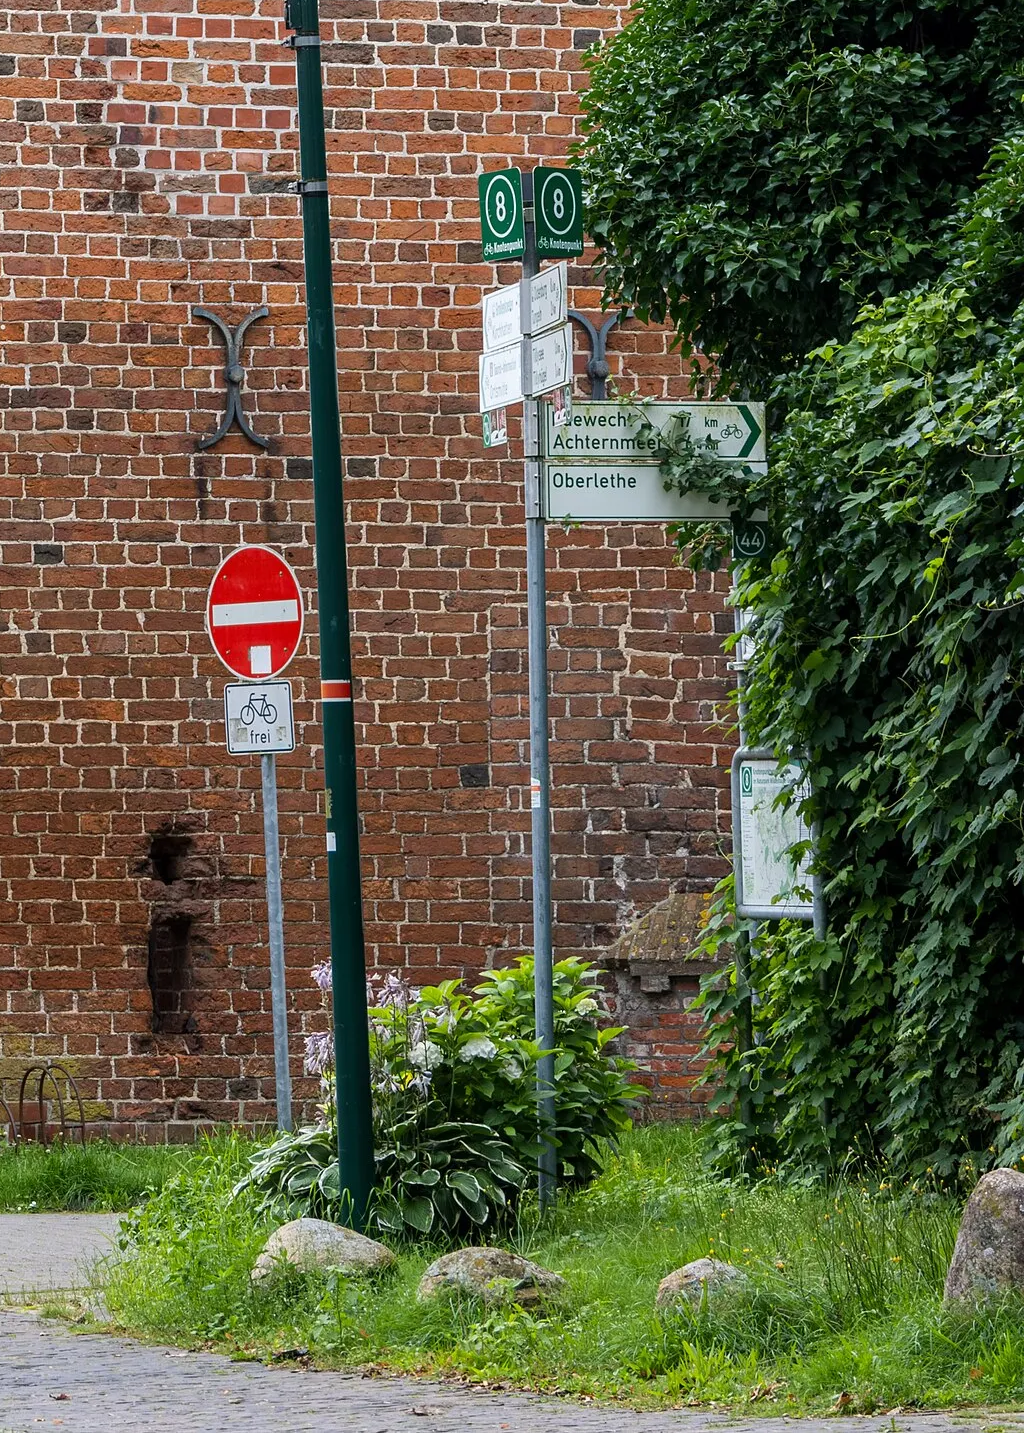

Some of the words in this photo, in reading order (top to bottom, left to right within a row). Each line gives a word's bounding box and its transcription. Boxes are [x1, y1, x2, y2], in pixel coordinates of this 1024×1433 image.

[495, 190, 507, 222] 8
[553, 188, 565, 219] 8
[493, 237, 524, 254] Knotenpunkt
[549, 237, 583, 252] Knotenpunkt
[704, 416, 718, 427] km
[552, 472, 637, 489] Oberlethe
[740, 533, 761, 548] 44
[250, 729, 271, 744] frei
